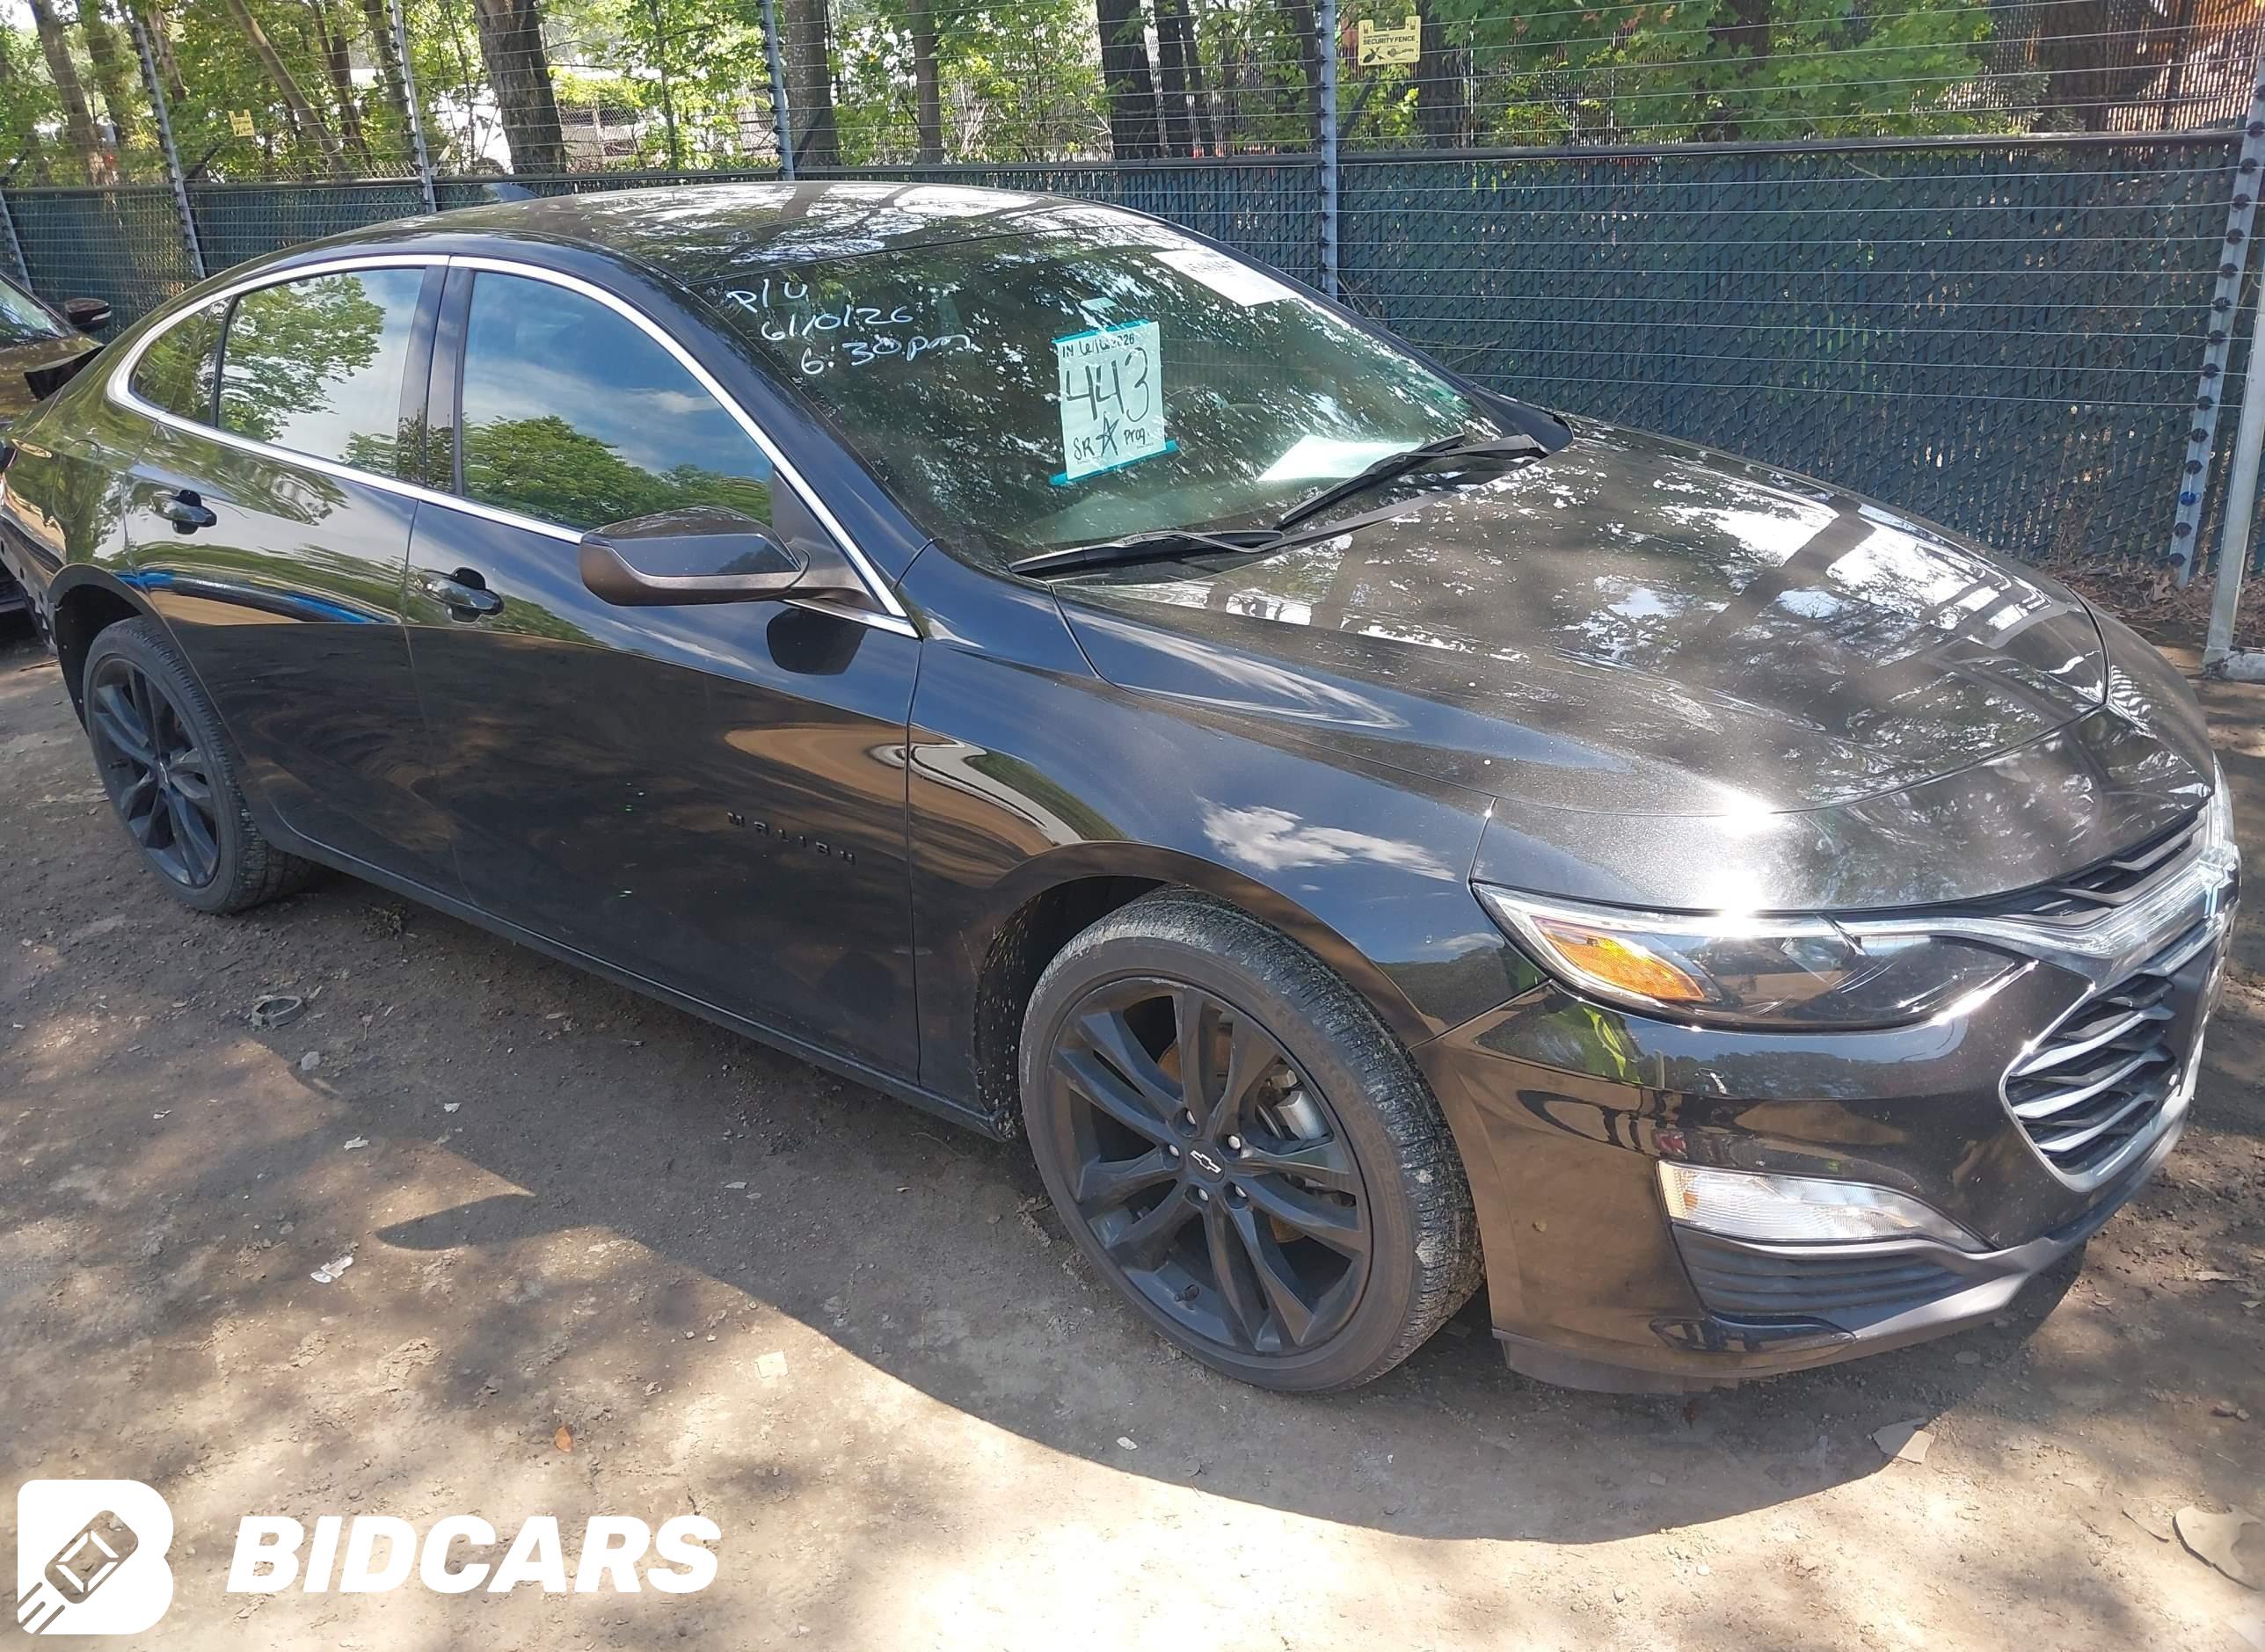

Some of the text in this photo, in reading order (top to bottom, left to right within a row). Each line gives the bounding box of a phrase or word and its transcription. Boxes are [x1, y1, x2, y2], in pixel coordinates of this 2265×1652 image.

[1062, 344, 1074, 358] IN
[1066, 346, 1148, 422] 443
[1073, 436, 1096, 461] SR
